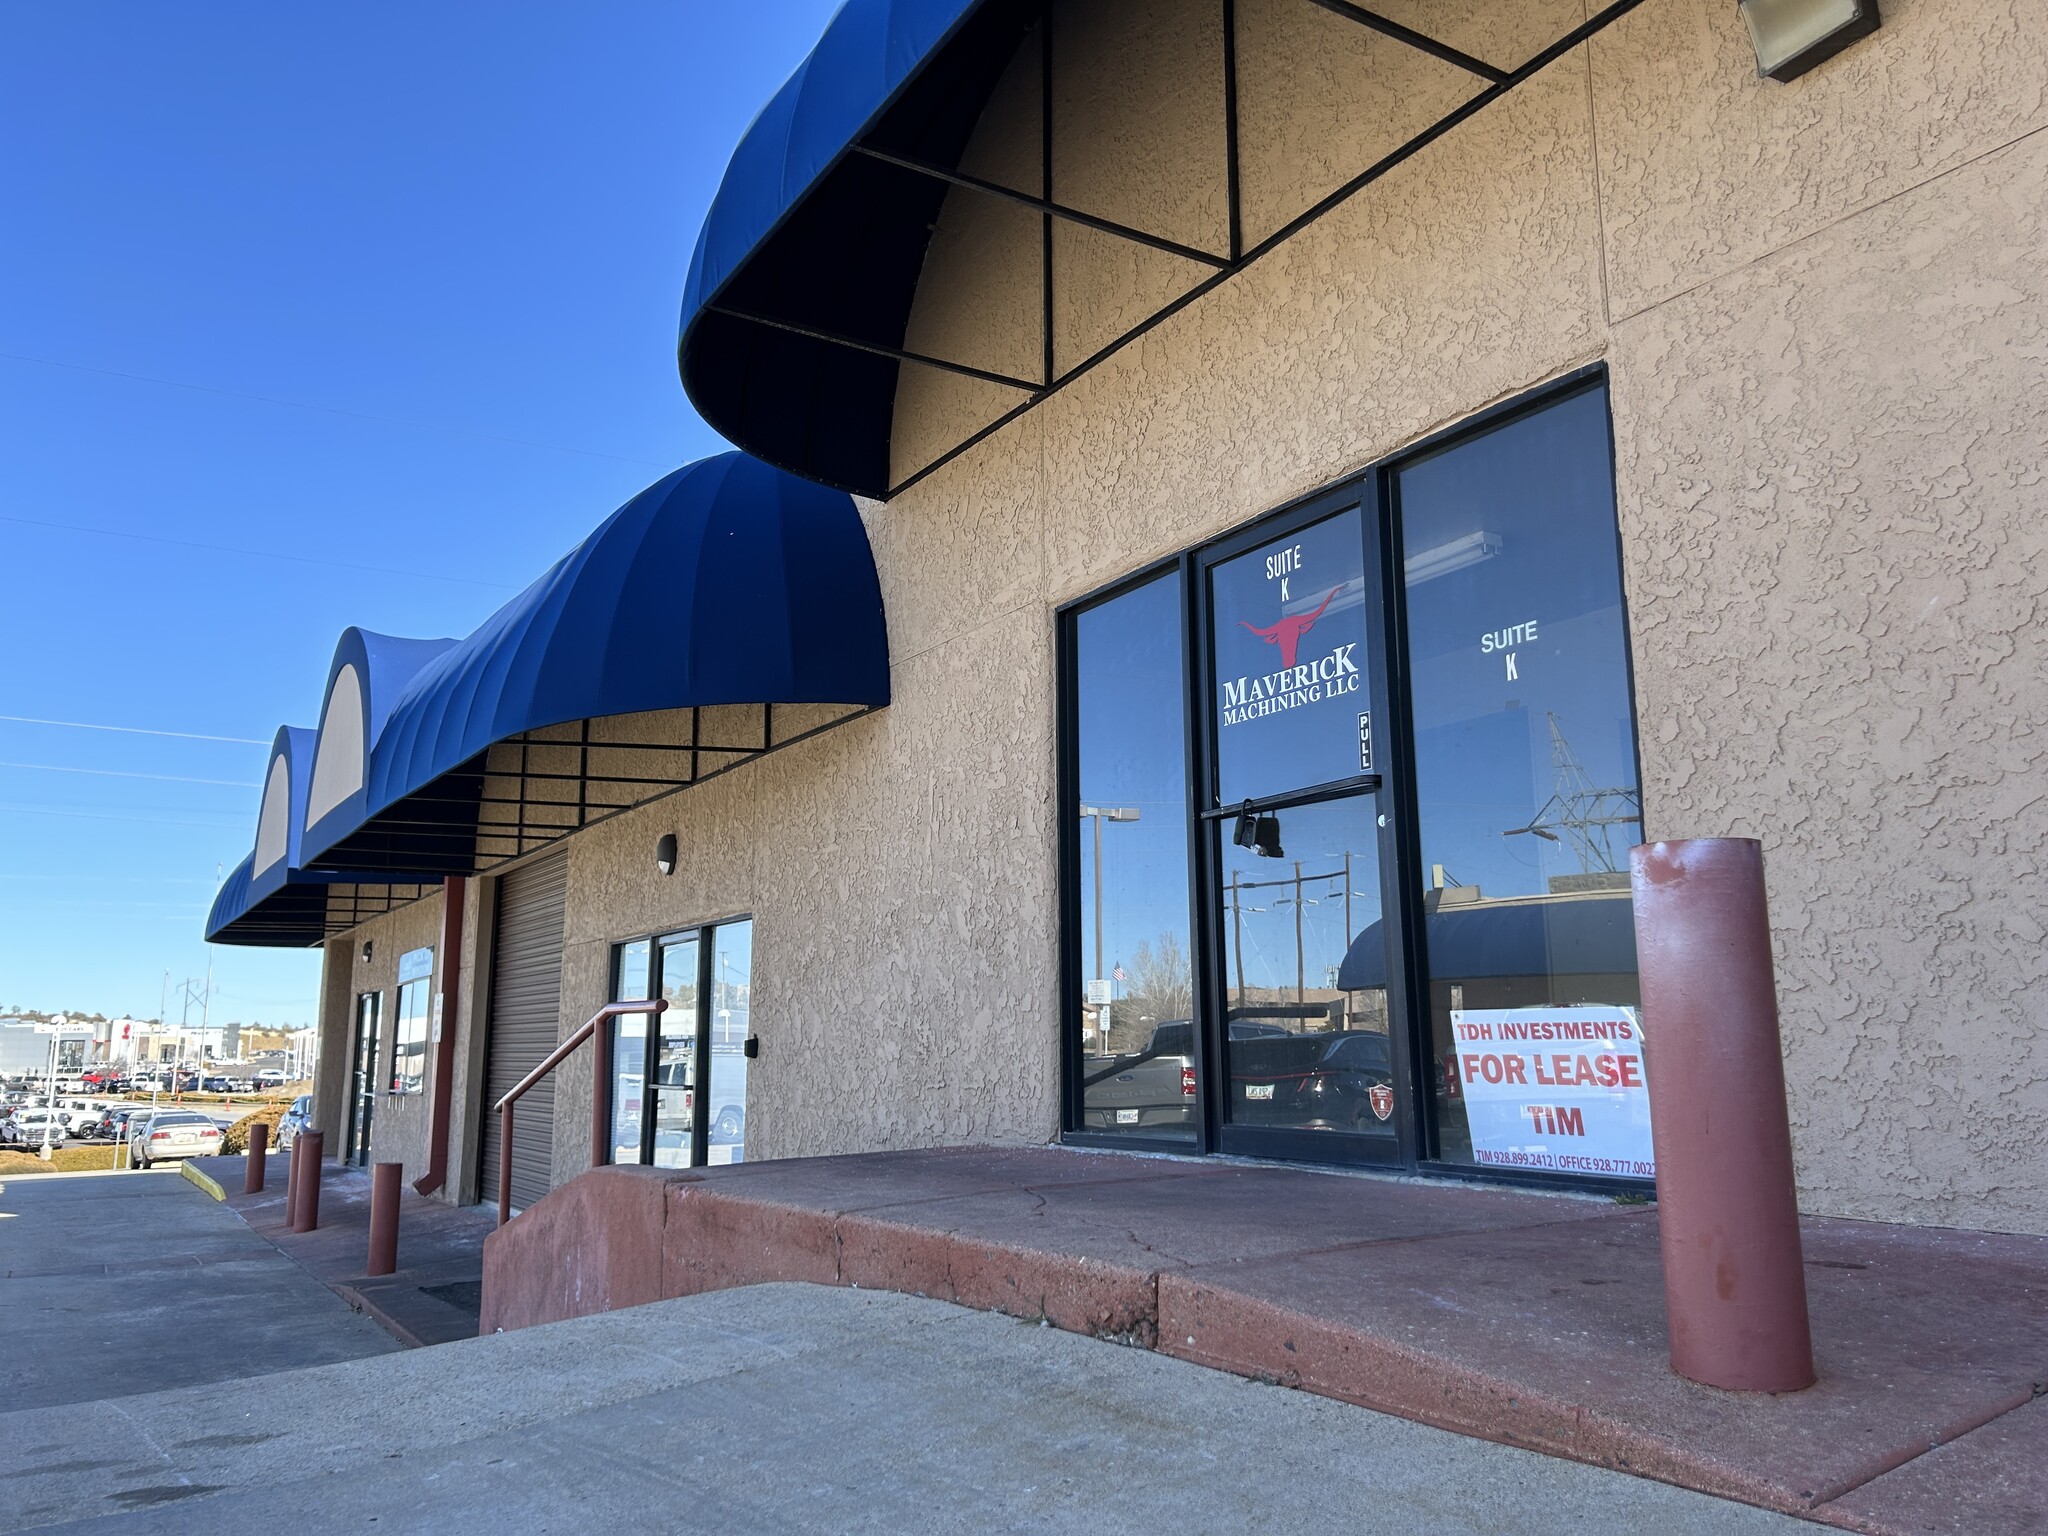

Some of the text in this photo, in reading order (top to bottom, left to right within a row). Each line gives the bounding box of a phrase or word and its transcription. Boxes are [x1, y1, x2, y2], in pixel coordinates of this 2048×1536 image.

[1266, 544, 1301, 580] SUITE
[1281, 577, 1290, 602] K
[1481, 619, 1538, 653] SUITE
[1223, 642, 1359, 709] MAVERICK
[1505, 652, 1519, 682] K
[1223, 673, 1360, 727] MACHINING LLC
[1360, 715, 1370, 767] PULL
[1457, 1021, 1633, 1041] TDH INVESTMENTS
[1462, 1053, 1643, 1088] FOR LEASE
[1527, 1105, 1586, 1137] TIM
[1476, 1149, 1493, 1163] TIM
[1494, 1152, 1554, 1168] 928.899.2412
[1559, 1155, 1593, 1171] OFFICE
